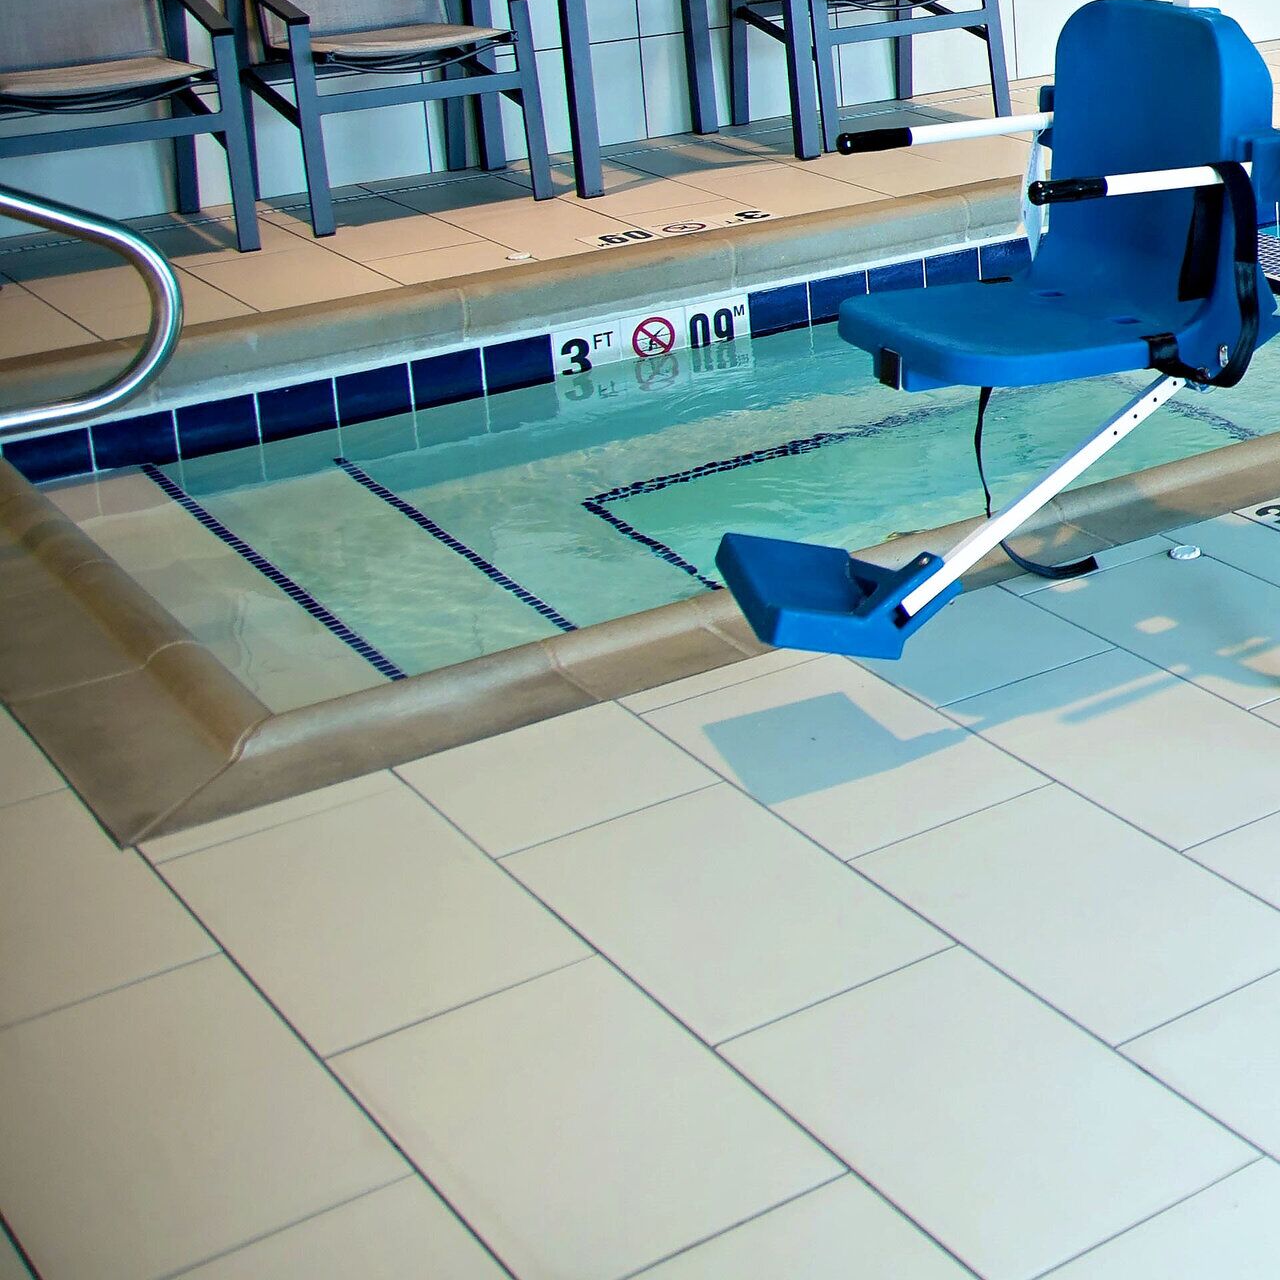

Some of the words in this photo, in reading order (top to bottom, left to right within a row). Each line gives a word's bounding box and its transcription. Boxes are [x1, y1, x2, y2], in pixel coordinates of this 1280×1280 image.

[561, 338, 593, 375] 3
[593, 331, 613, 349] FT
[733, 304, 745, 317] M
